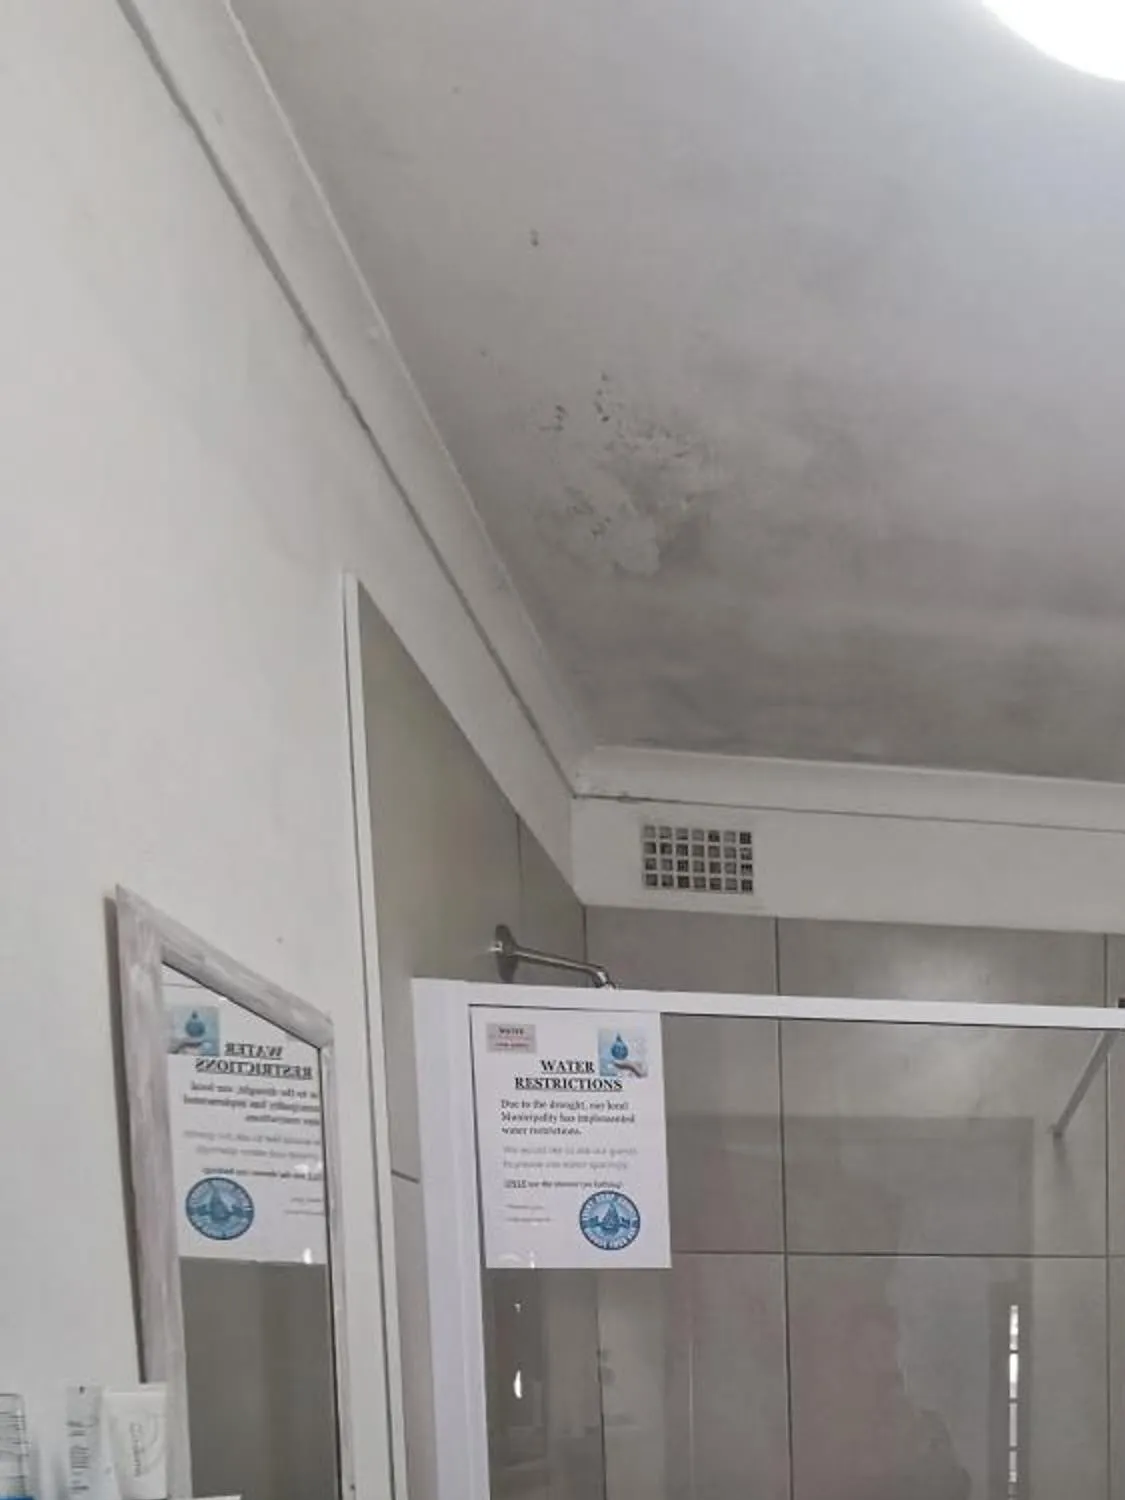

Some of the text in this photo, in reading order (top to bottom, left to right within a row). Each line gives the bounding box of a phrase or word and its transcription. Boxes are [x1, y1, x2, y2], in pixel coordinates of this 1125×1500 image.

[540, 1060, 595, 1073] WATER
[514, 1077, 624, 1092] RESTRICTIONS
[500, 1100, 519, 1109] Due
[521, 1100, 531, 1109] to
[533, 1100, 546, 1109] the
[560, 1112, 576, 1122] has
[578, 1113, 635, 1124] implemented
[501, 1127, 527, 1135] water
